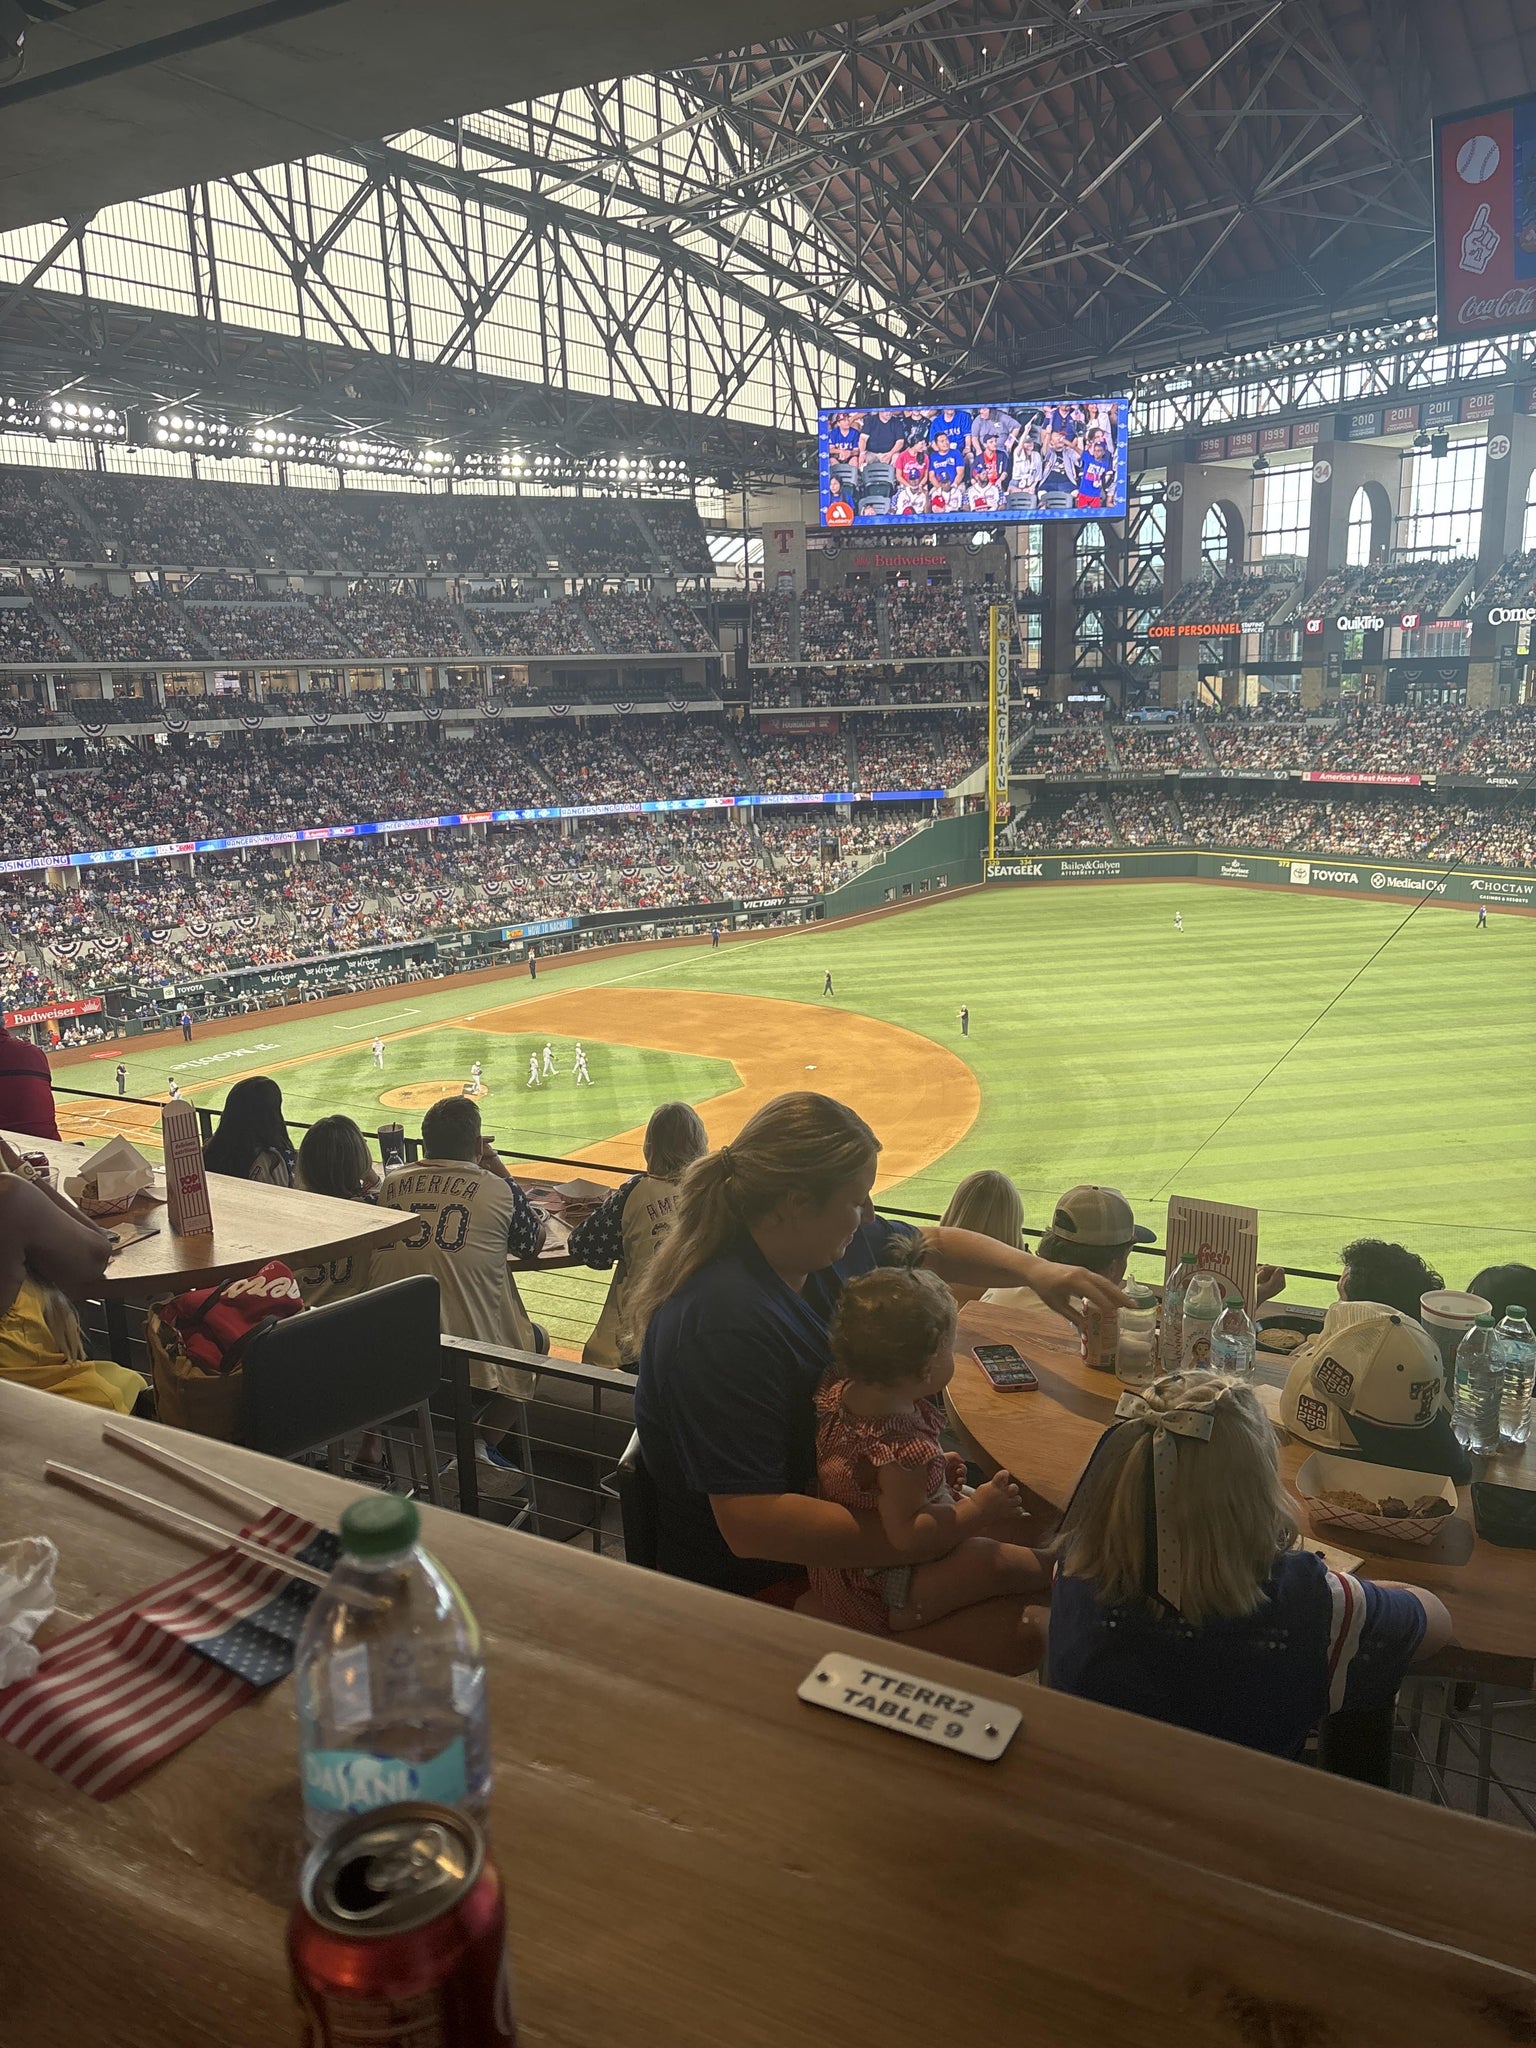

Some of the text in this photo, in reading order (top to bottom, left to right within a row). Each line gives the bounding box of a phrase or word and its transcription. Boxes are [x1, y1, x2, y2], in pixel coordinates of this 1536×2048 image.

[1429, 401, 1450, 414] 2011
[1470, 395, 1494, 408] 2012
[1352, 413, 1374, 427] 2010
[1391, 408, 1412, 421] 2011
[1233, 434, 1252, 446] 1998
[1265, 428, 1285, 440] 1999
[1201, 439, 1220, 451] 1996
[1490, 441, 1508, 456] 26
[1315, 466, 1329, 479] 34
[1168, 485, 1181, 497] 42
[1306, 619, 1322, 632] QT
[1337, 615, 1385, 632] QuikTrip
[1402, 614, 1418, 628] QT
[1149, 623, 1241, 638] CORE PERSONNEL
[1319, 773, 1411, 783] America's Best Network
[1486, 777, 1519, 785] ARENA
[562, 806, 596, 815] RANGERS
[597, 805, 614, 813] SING
[7, 860, 31, 870] SING
[34, 855, 67, 867] ALONG
[987, 864, 1043, 878] SEATGEEK
[1312, 869, 1359, 884] TOYOTA
[1387, 876, 1448, 894] Medical City
[1476, 879, 1534, 894] CHOCTAW
[315, 964, 340, 978] Kroger
[357, 957, 381, 971] Kroger
[271, 971, 298, 985] Kroger
[177, 984, 205, 994] TOYOTA
[14, 1007, 76, 1025] Budweiser
[180, 1174, 198, 1185] POP
[182, 1183, 201, 1195] CORN
[386, 1174, 481, 1201] AMERICA
[1197, 1243, 1230, 1269] fresh
[1325, 1359, 1350, 1383] USA
[1316, 1371, 1348, 1397] 250
[1300, 1397, 1325, 1414] USA
[1297, 1409, 1327, 1430] 250
[861, 1669, 975, 1718] TTERR2
[842, 1688, 964, 1739] TABLE 9
